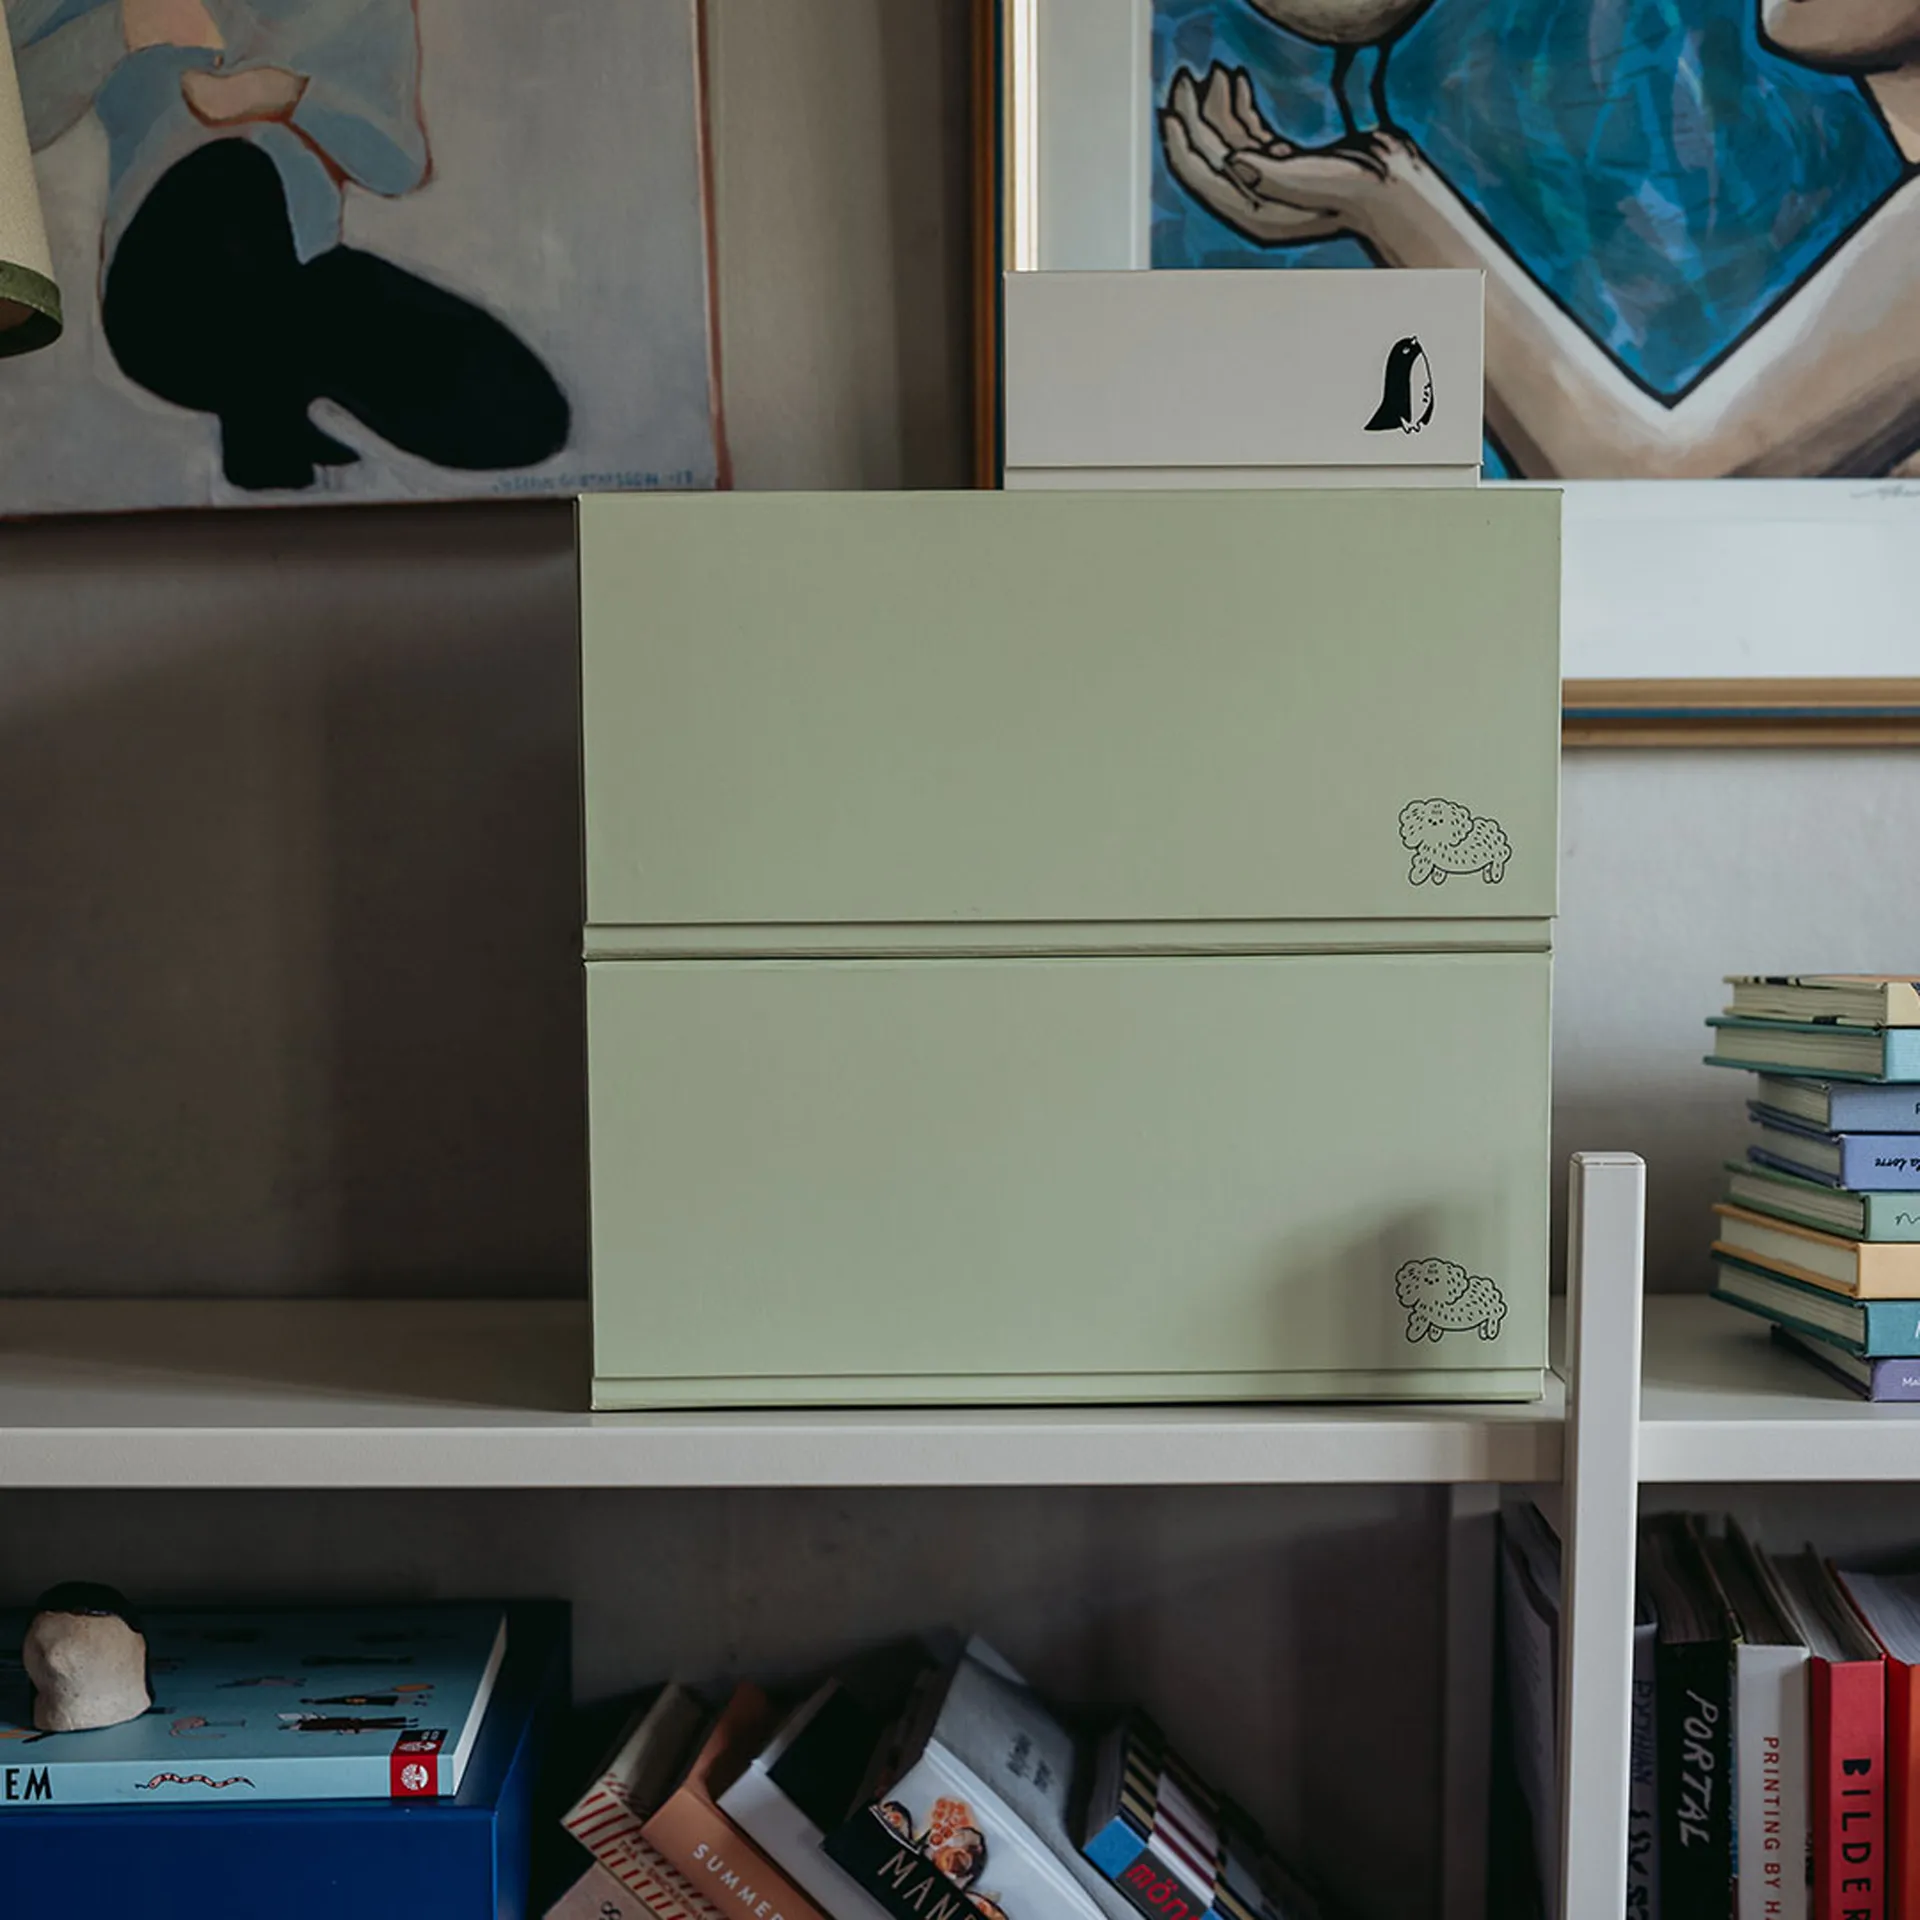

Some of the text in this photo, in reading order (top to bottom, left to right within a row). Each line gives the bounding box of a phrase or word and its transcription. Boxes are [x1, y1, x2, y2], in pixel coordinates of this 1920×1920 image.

[5, 1765, 53, 1801] EM
[1677, 1688, 1719, 1848] PORTAL
[877, 1849, 978, 1920] MAN
[1763, 1736, 1782, 1920] PRINTING BY H
